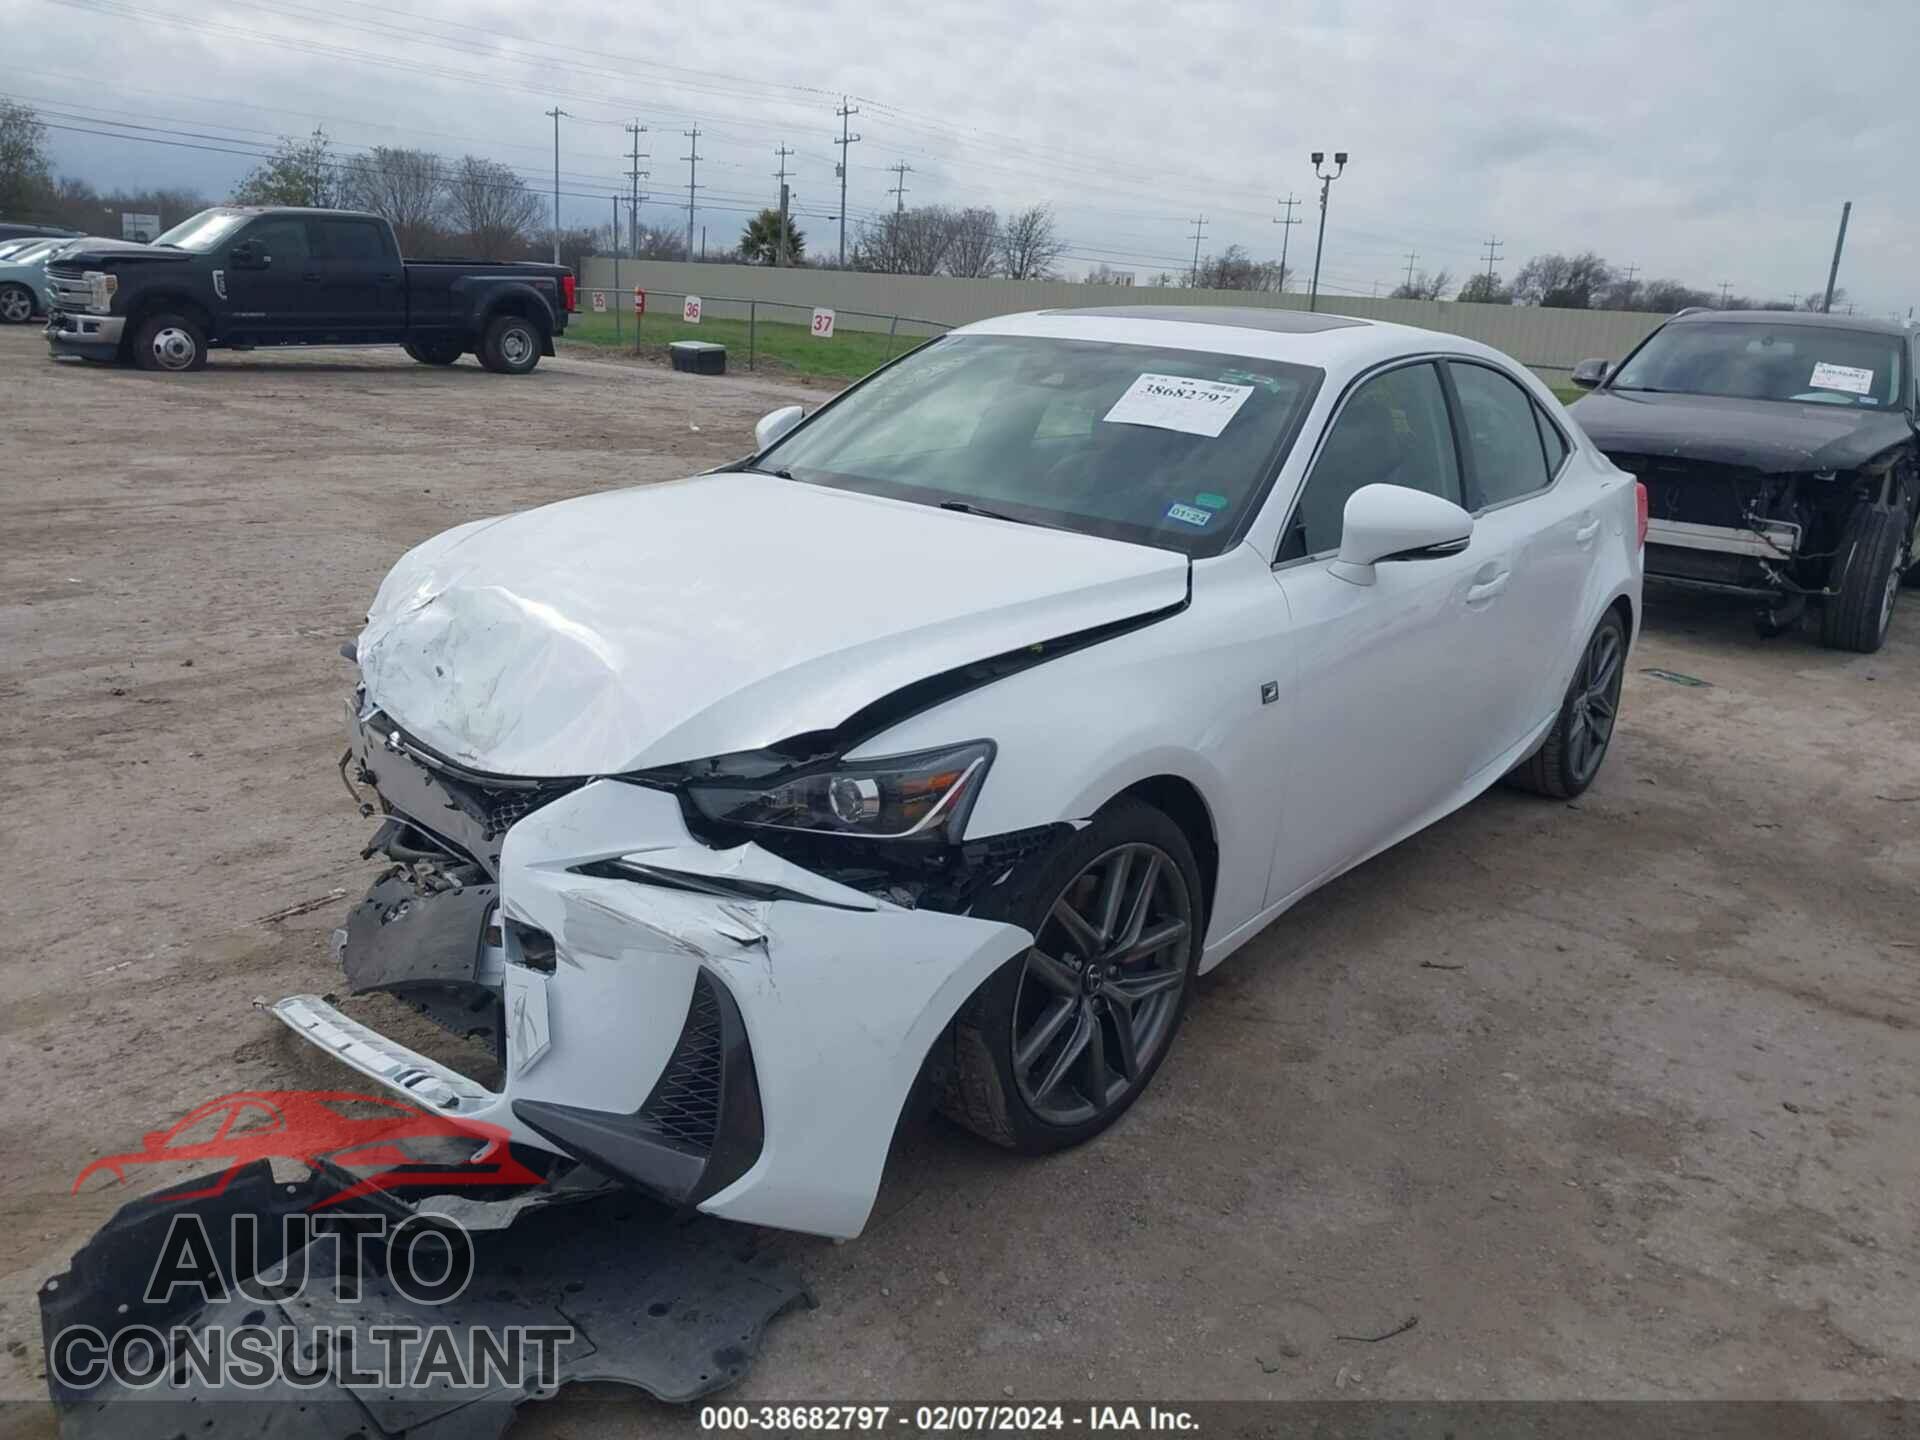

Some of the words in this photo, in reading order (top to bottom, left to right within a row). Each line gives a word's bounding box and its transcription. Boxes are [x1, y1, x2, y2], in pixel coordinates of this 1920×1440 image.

[685, 302, 699, 318] 36
[813, 314, 833, 333] 37
[1140, 384, 1231, 405] 38682797
